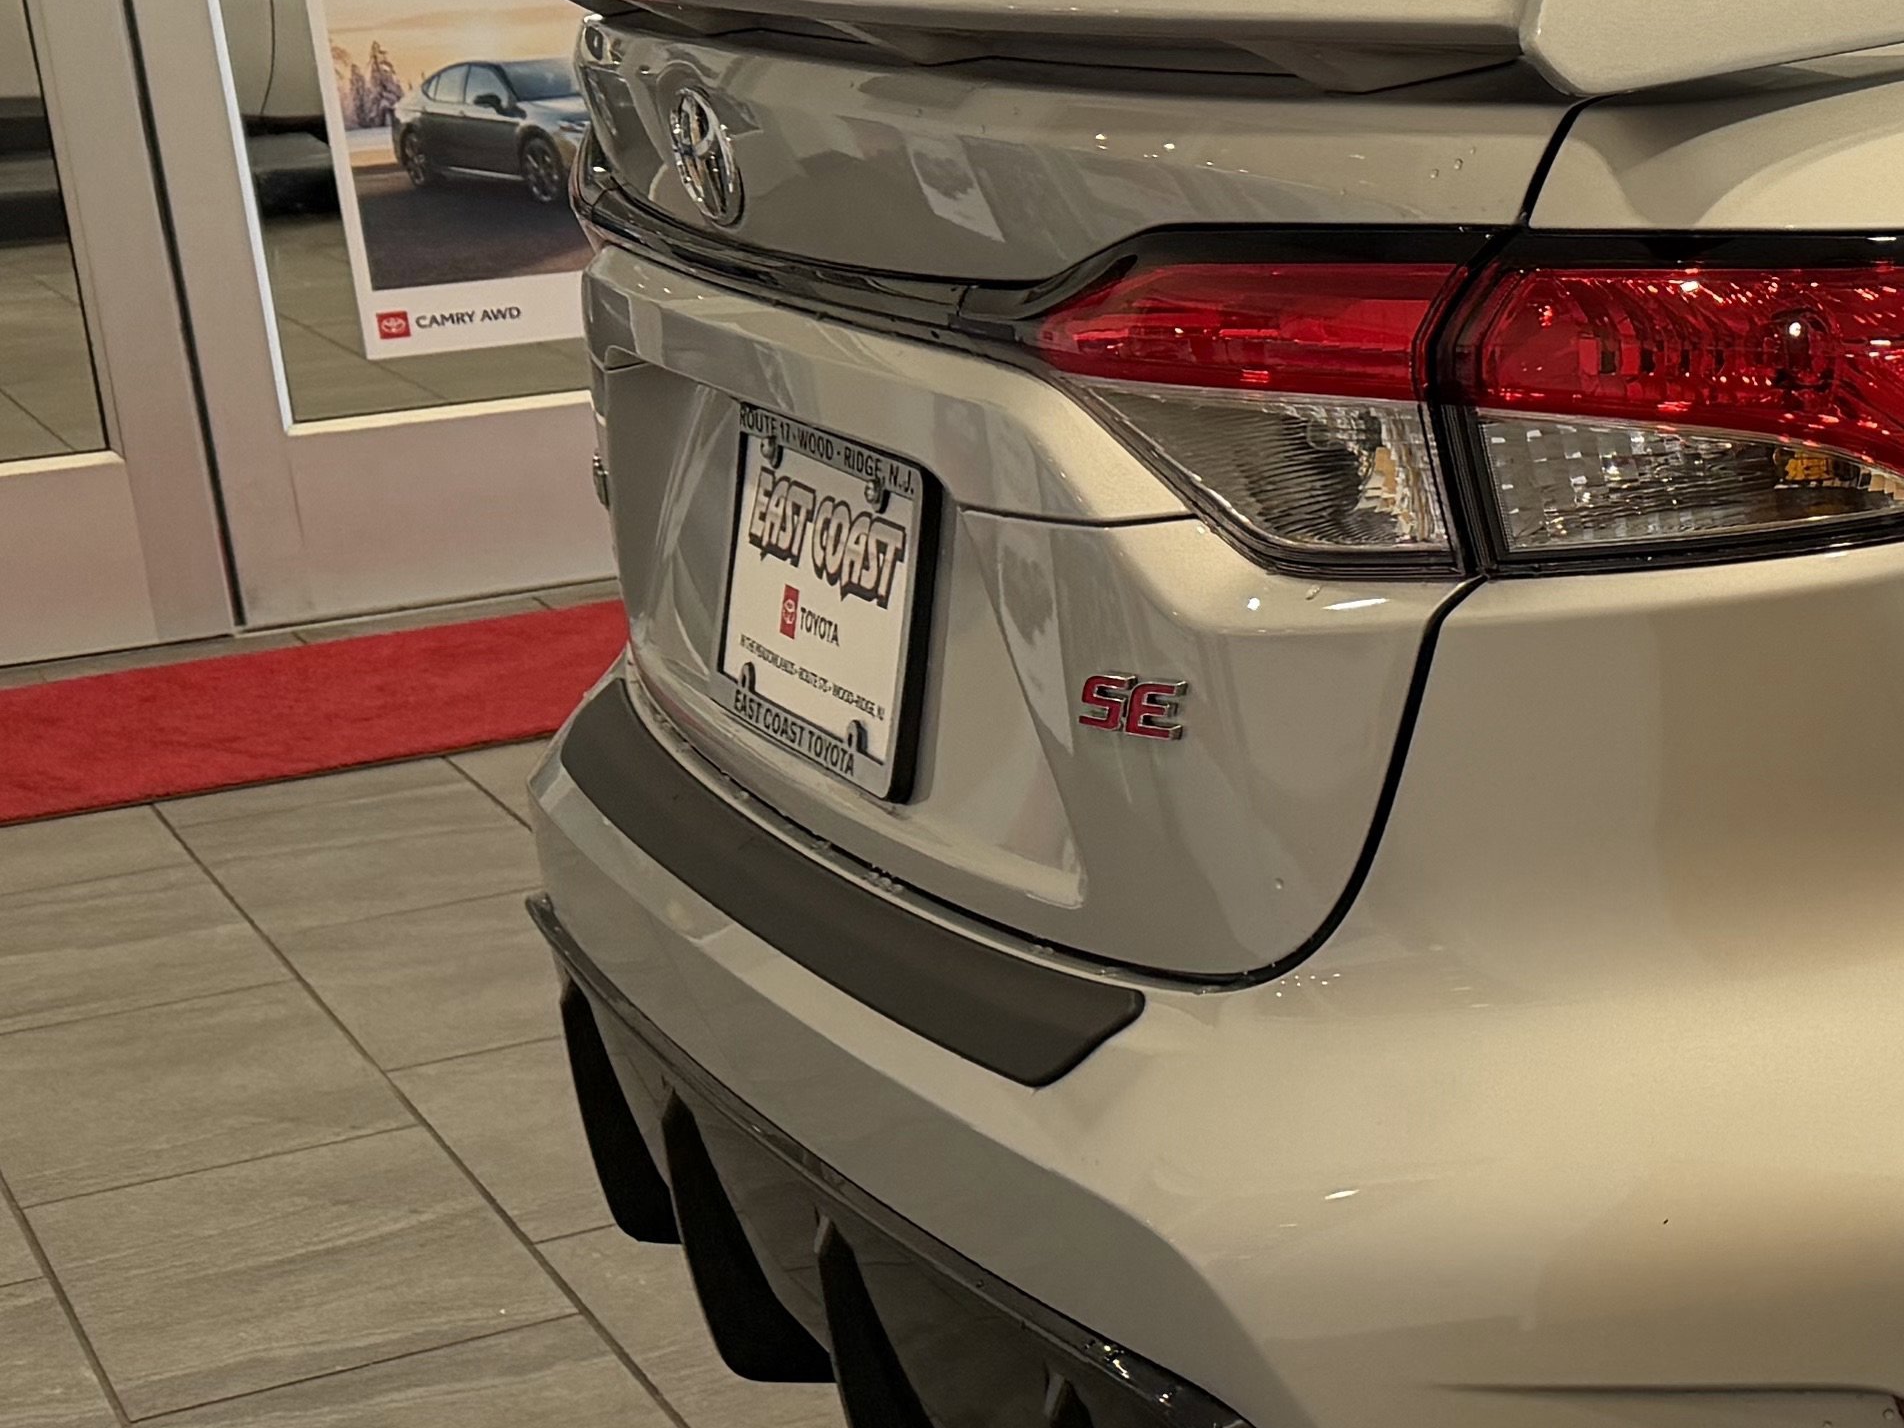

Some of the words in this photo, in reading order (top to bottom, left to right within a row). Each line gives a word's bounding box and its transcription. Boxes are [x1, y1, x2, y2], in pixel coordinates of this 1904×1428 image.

[415, 311, 476, 330] CAMRY
[480, 306, 522, 322] AWD
[739, 405, 777, 438] ROUTE
[779, 421, 791, 441] 17
[796, 427, 834, 461] WOOD
[888, 463, 916, 495] N.J.
[749, 465, 817, 569] EAST
[811, 494, 907, 610] COAST
[800, 606, 840, 648] TOYOTA
[733, 688, 762, 724] EAST
[763, 705, 806, 748] COAST
[808, 729, 855, 777] TOYOTA
[1078, 670, 1189, 741] SE
